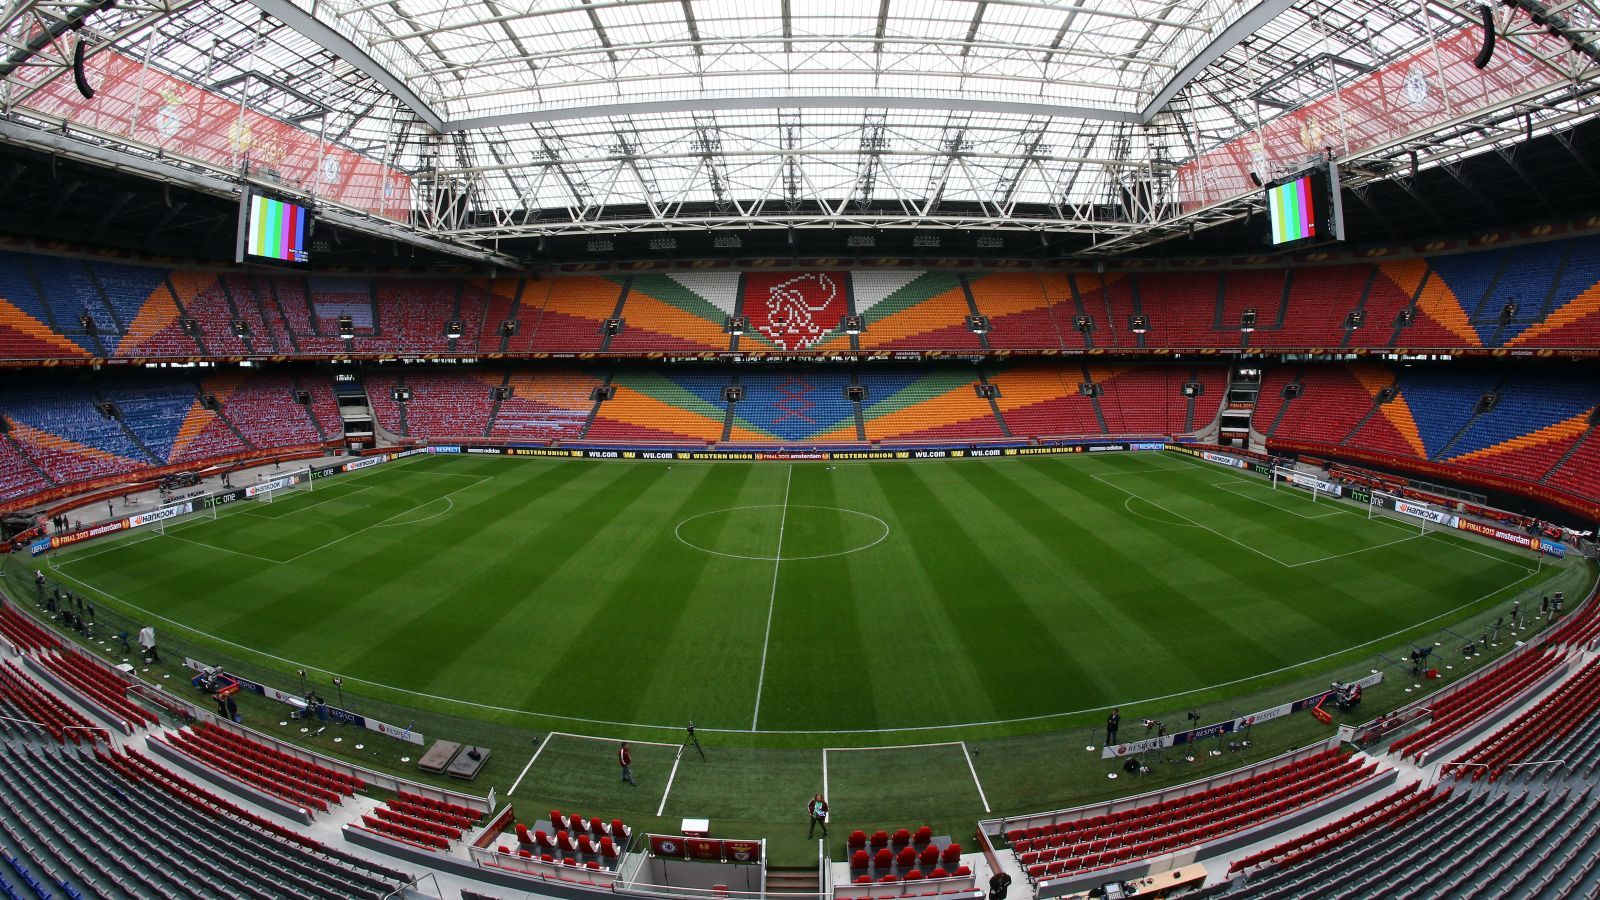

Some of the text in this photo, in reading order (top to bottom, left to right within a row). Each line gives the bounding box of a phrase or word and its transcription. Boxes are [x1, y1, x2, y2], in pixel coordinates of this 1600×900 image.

[324, 468, 333, 477] one
[223, 493, 235, 503] one
[60, 522, 121, 544] FINAL 2013 amsterdam
[1466, 522, 1530, 546] FINAL 2013 amsterdam
[331, 710, 355, 722] RESPECT
[1256, 709, 1280, 721] RESPECT
[1195, 725, 1223, 738] RESPECT
